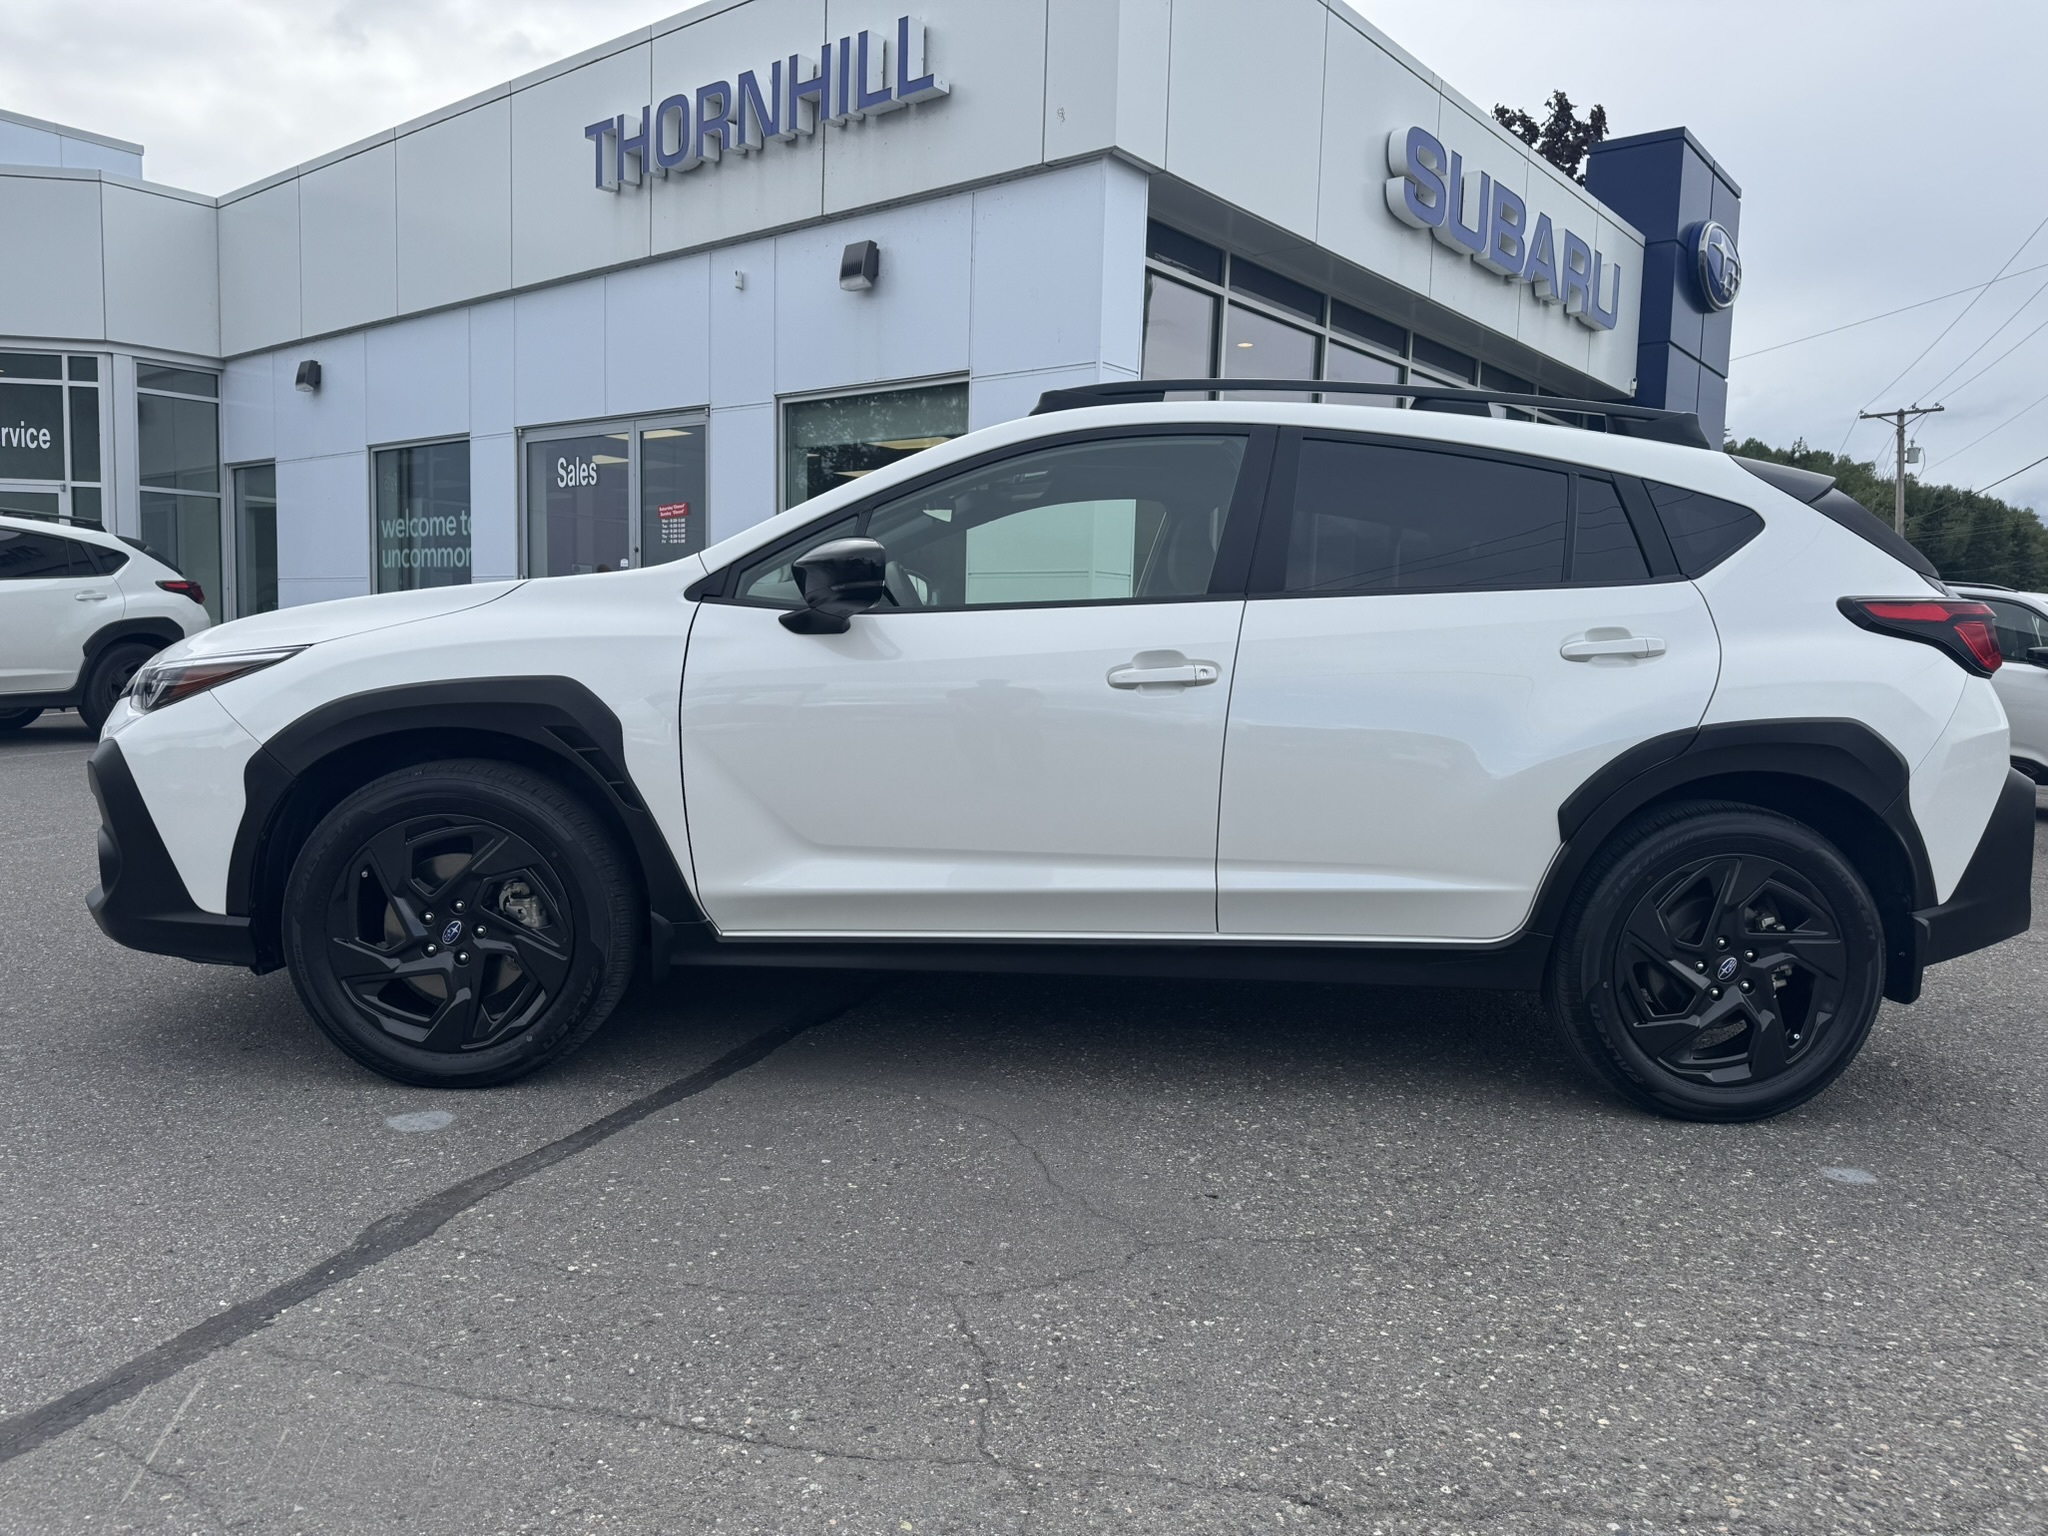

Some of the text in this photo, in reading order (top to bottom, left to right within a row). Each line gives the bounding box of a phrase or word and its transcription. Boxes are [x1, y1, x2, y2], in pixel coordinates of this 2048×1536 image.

[585, 15, 947, 192] THORNHILL
[1389, 126, 1621, 331] SUBARU
[1, 420, 51, 449] rvice
[557, 456, 598, 488] Sales
[381, 508, 457, 538] welcome
